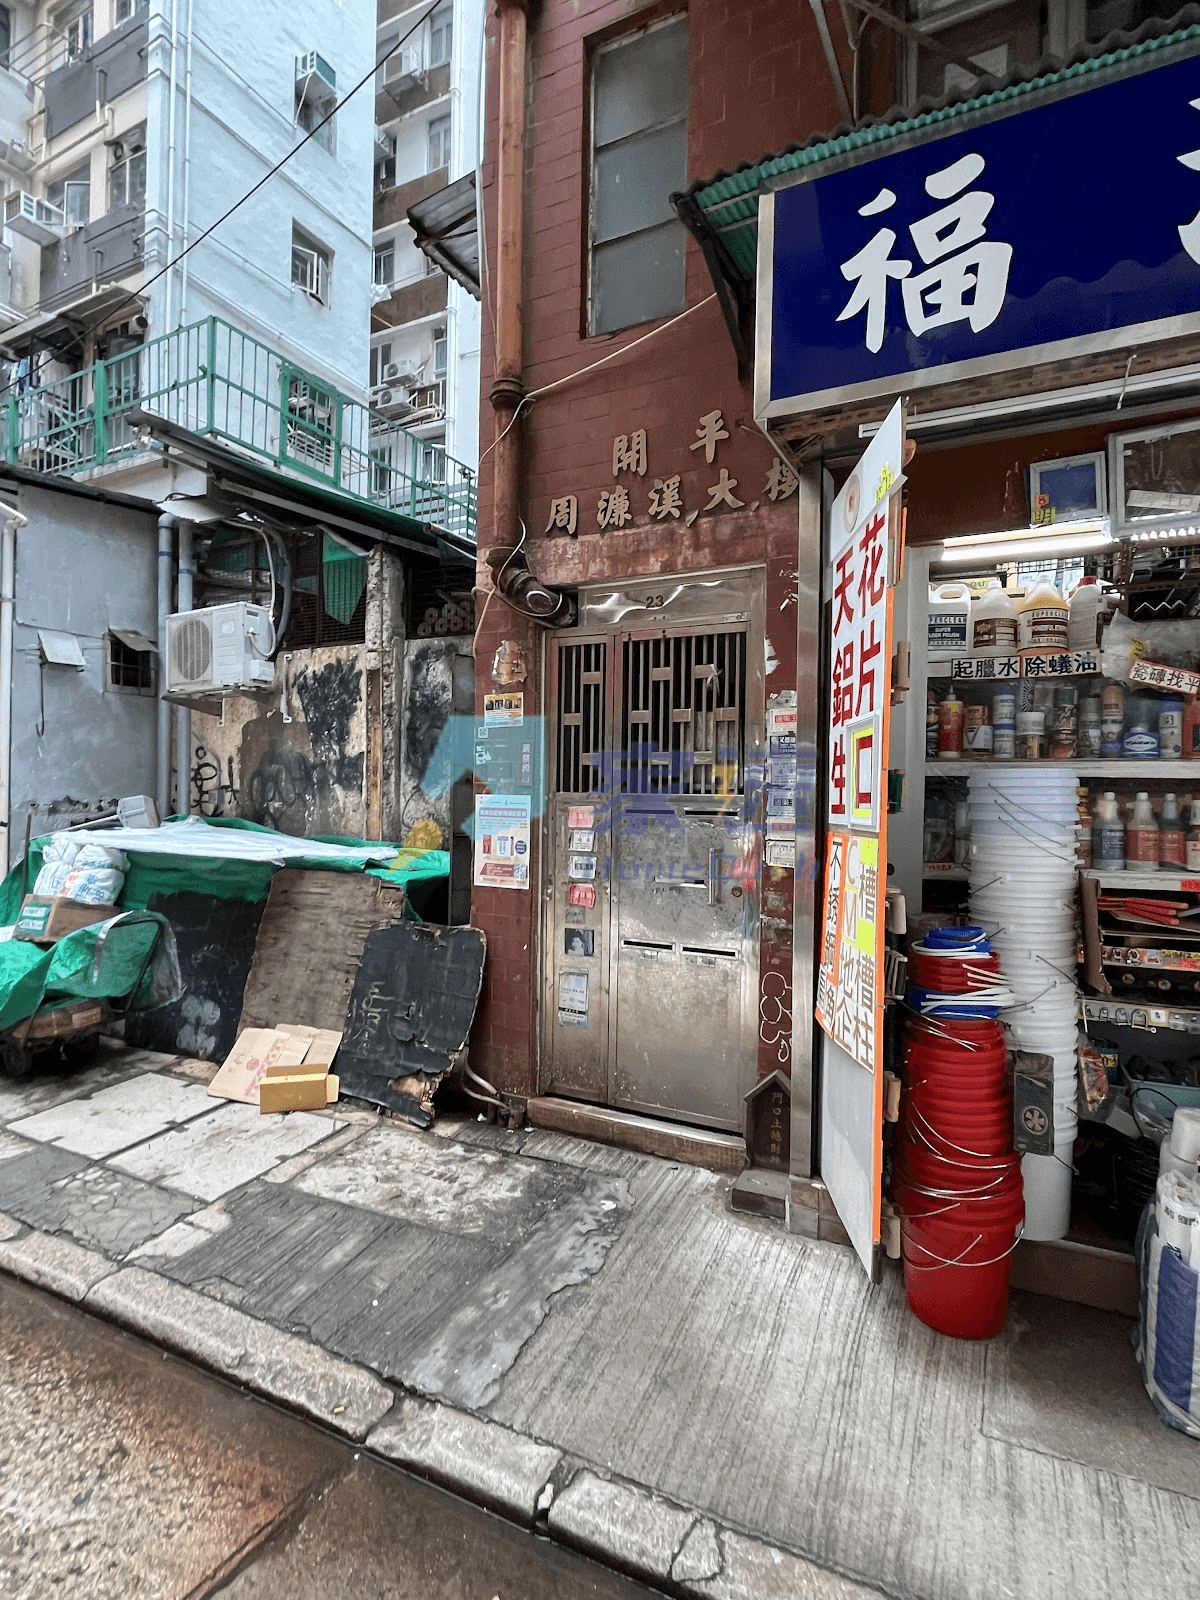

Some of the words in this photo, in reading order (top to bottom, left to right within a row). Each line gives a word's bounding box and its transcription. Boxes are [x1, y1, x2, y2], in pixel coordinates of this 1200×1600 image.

[835, 153, 1013, 354] 福
[612, 409, 730, 477] 開平
[645, 594, 664, 609] 23
[1025, 652, 1097, 676] 除蟻油
[1132, 662, 1200, 692] 瓷磚找平
